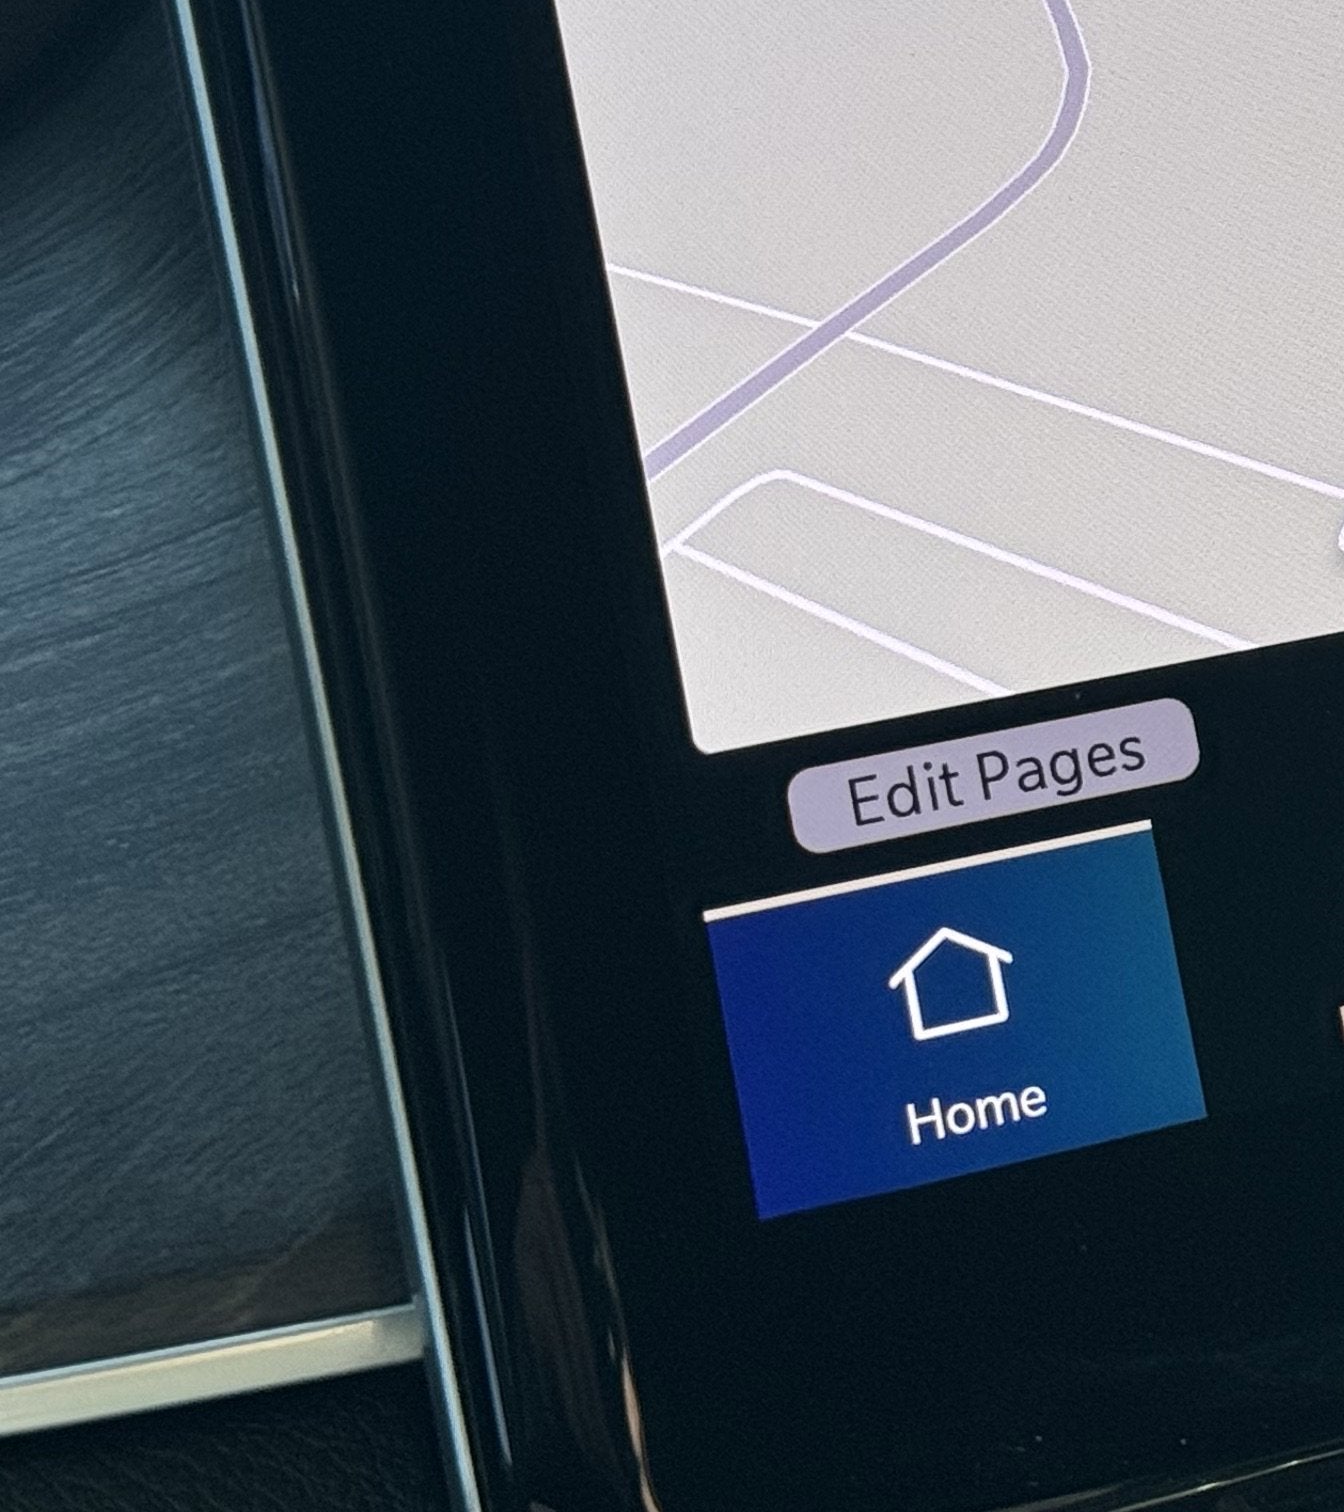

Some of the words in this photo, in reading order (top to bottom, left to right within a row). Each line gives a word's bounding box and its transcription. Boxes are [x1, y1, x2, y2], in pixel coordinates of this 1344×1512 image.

[847, 761, 963, 827] Edit
[974, 730, 1147, 802] Pages
[905, 1082, 1048, 1146] Home
